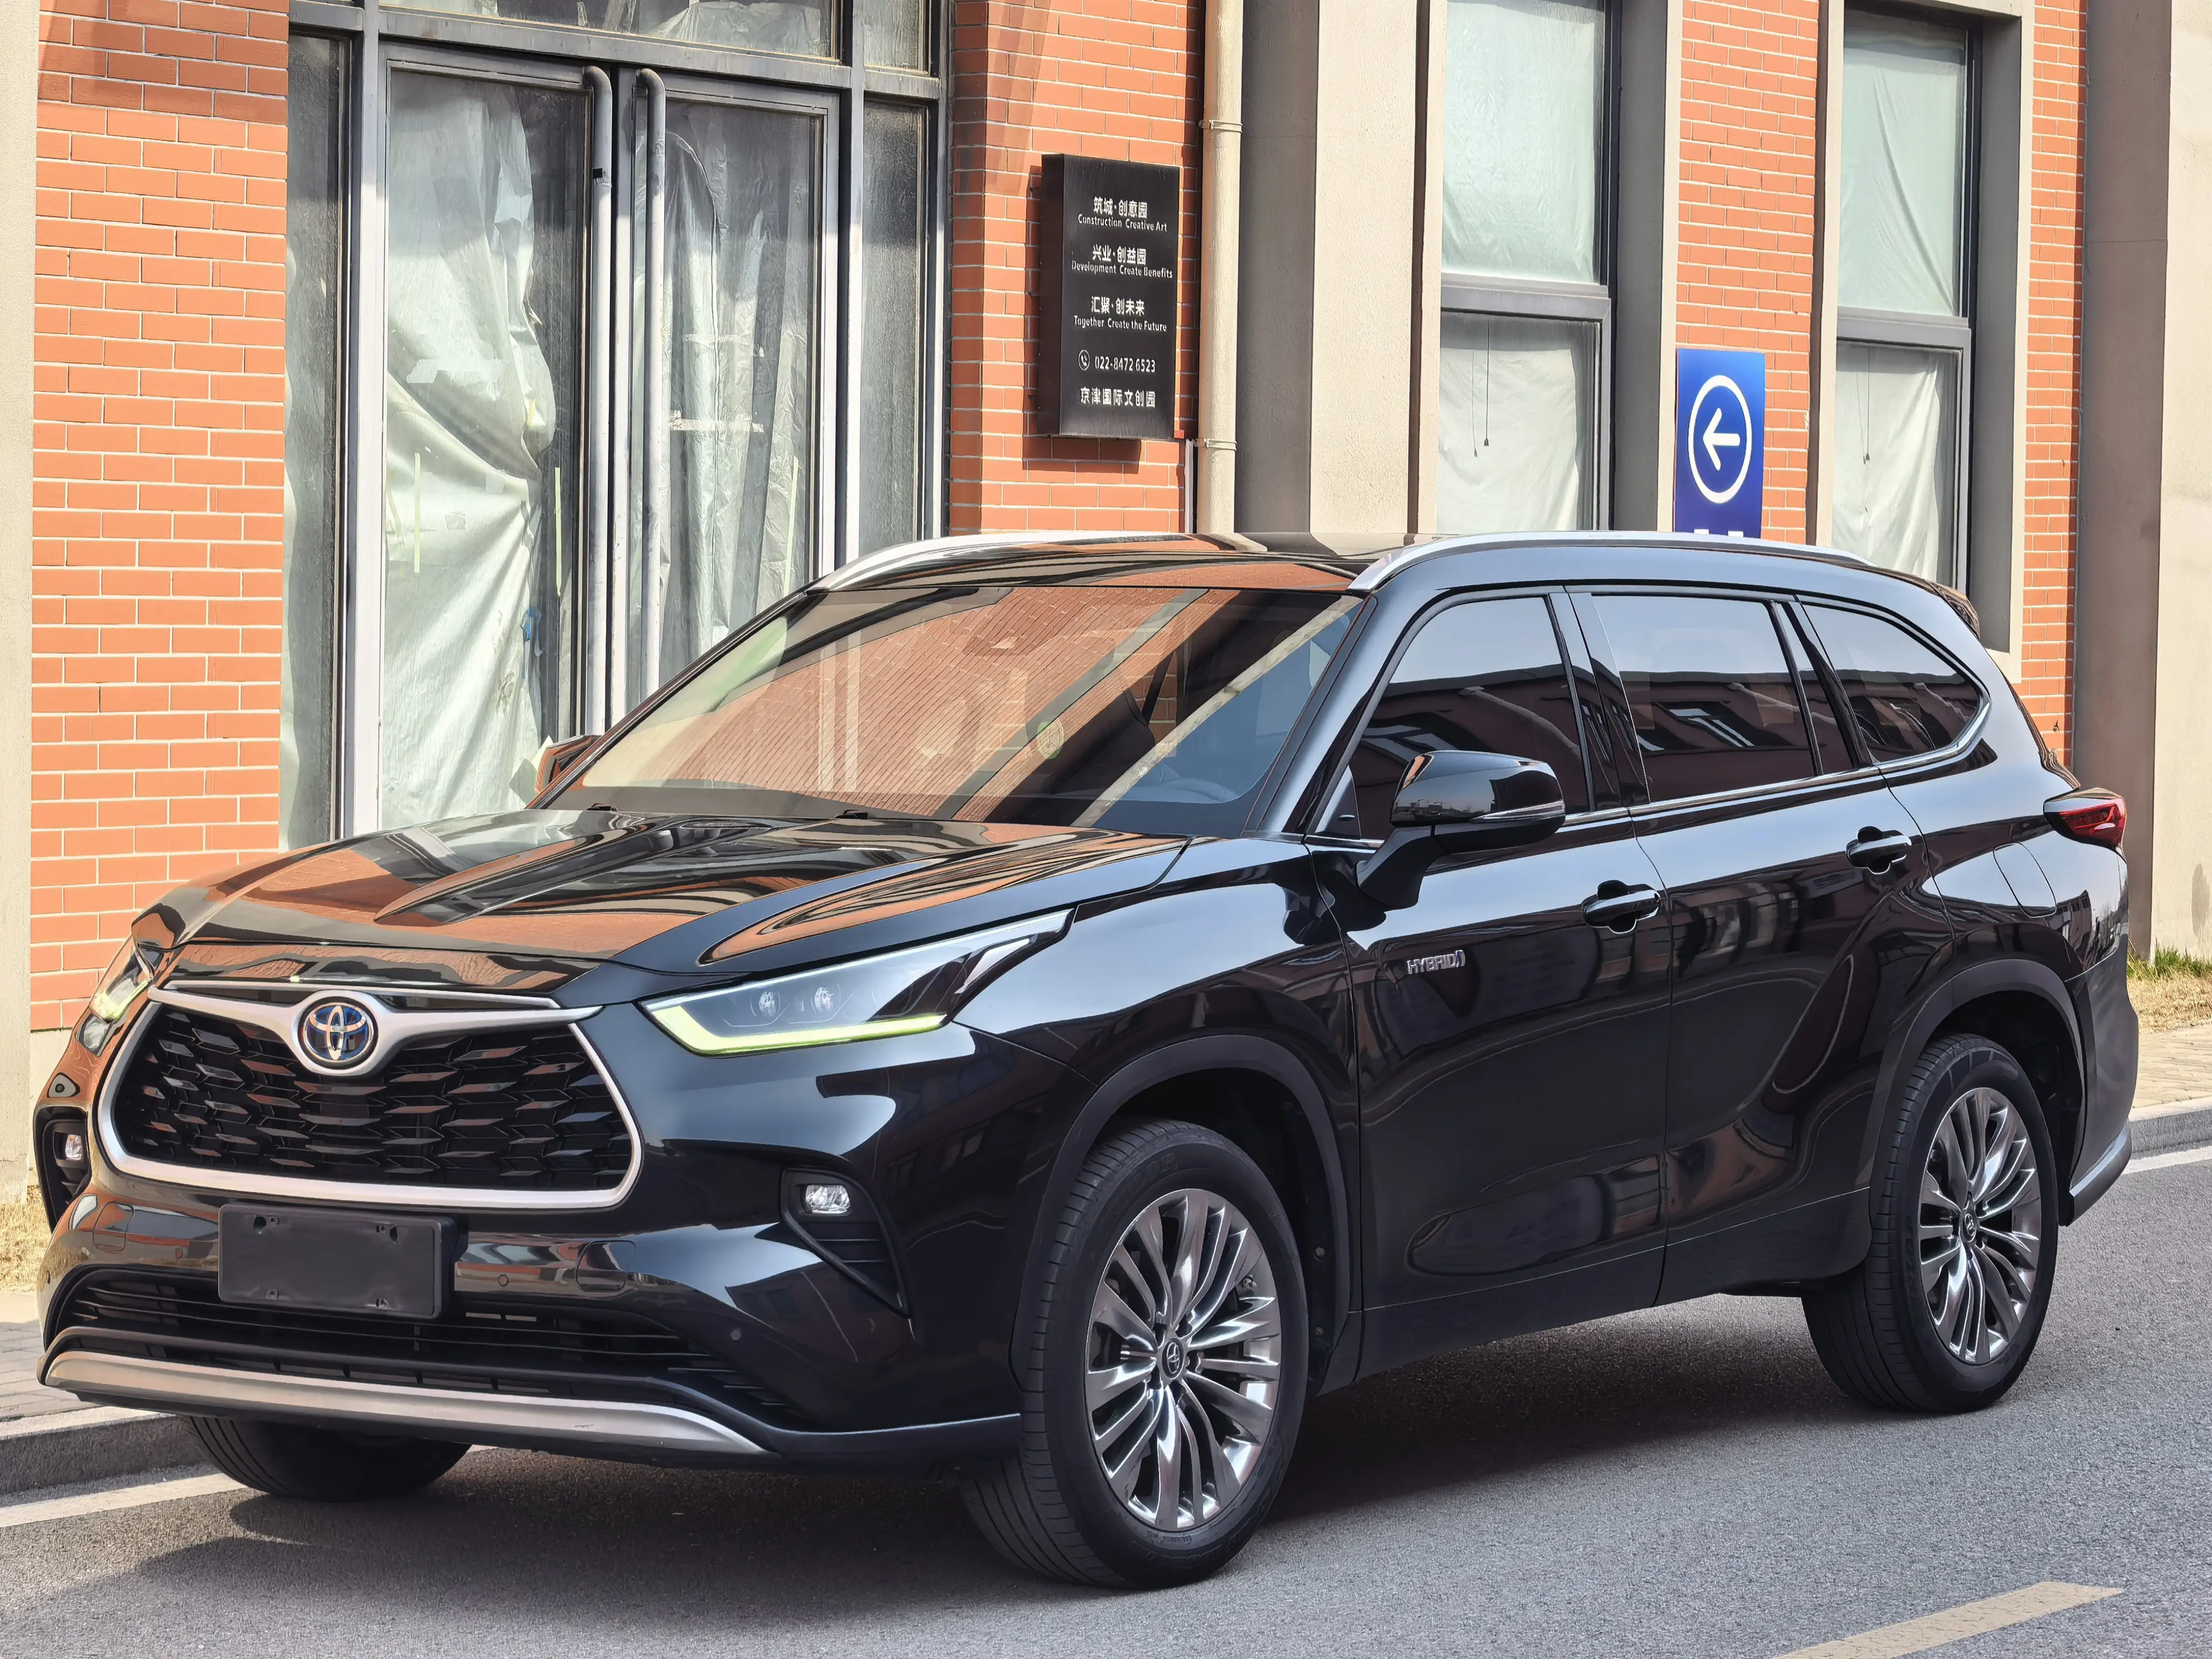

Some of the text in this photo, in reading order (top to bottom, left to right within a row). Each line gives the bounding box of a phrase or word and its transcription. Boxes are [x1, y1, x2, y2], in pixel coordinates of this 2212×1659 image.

[1094, 196, 1147, 218] 筑城·创意园
[1078, 214, 1167, 232] Construction Creative Art
[1092, 244, 1147, 265] 兴业·创益园
[1071, 260, 1173, 278] Development Create Benefits
[1074, 315, 1167, 332] Together Create the Future
[1080, 387, 1156, 408] 京津国际文创园
[1407, 953, 1457, 974] HYBRID
